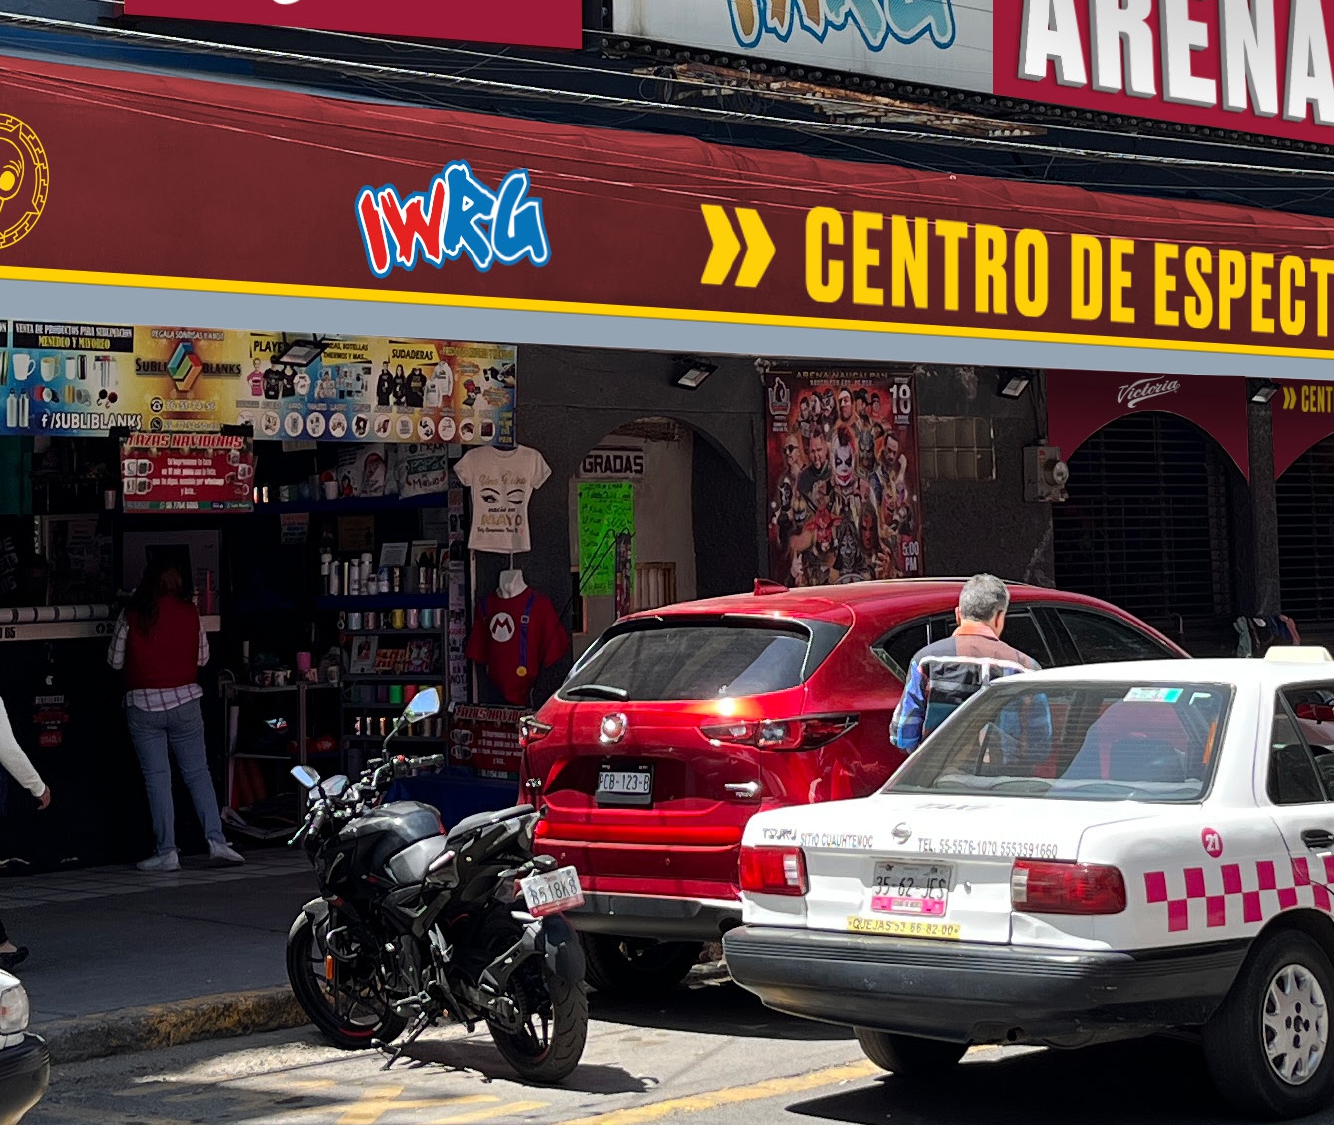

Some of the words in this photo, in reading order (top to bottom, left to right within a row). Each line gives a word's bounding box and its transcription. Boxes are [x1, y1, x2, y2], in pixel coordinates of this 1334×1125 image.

[355, 159, 552, 279] IWRG
[804, 206, 1050, 318] CENTRO
[1071, 233, 1135, 326] DE
[1117, 374, 1181, 409] Victoria
[582, 453, 644, 474] GRADAS
[799, 832, 820, 847] SITIO
[1205, 832, 1220, 851] 21
